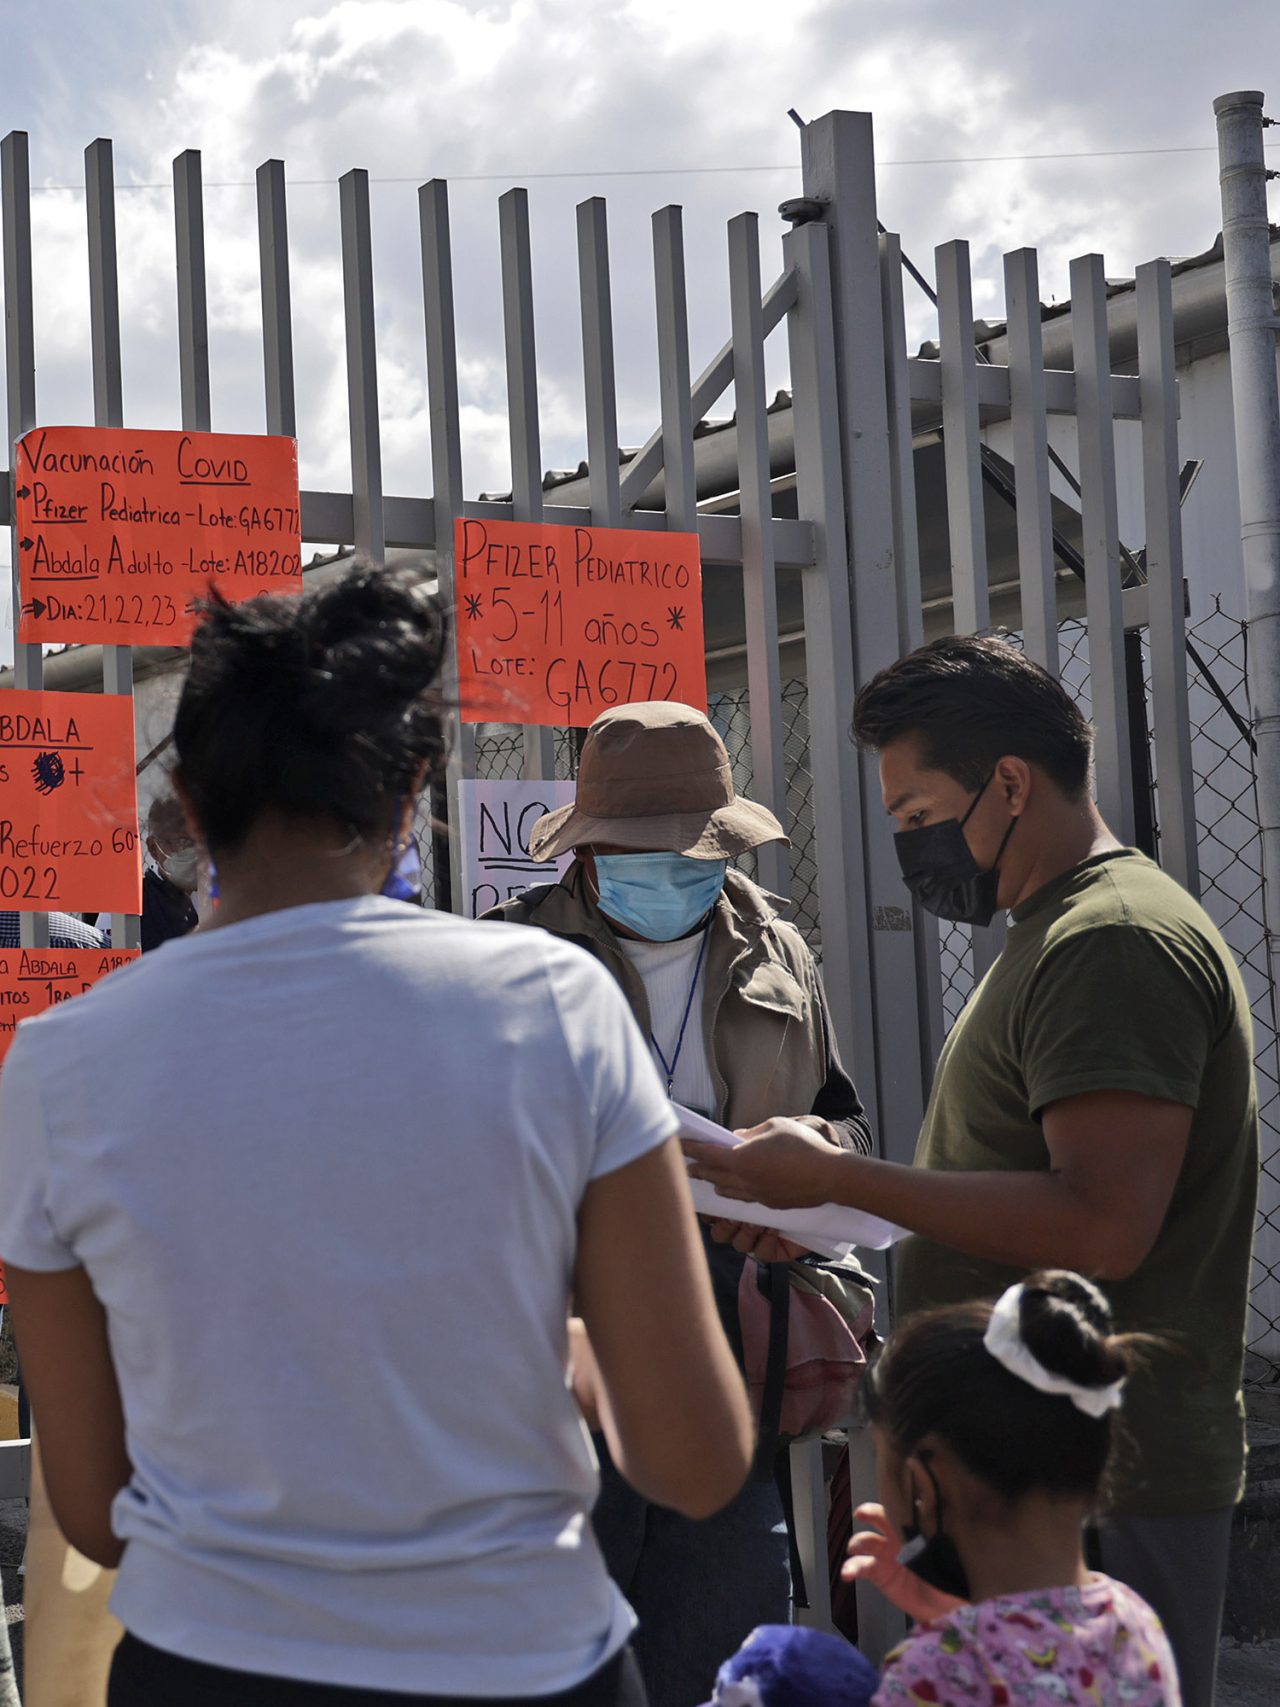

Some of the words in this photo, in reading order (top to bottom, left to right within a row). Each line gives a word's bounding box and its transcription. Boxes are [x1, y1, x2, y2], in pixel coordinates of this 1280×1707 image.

[33, 482, 88, 519] Pfizer
[101, 482, 181, 525] Pediatrica
[33, 534, 100, 575] Abdala
[107, 535, 174, 575] Adulto
[462, 520, 560, 584] PFIZER
[575, 528, 690, 588] PEDIATRICO
[584, 614, 660, 646] años
[472, 649, 535, 677] LOTE:
[0, 820, 103, 858] Refuerzo
[20, 950, 77, 975] ABDALA
